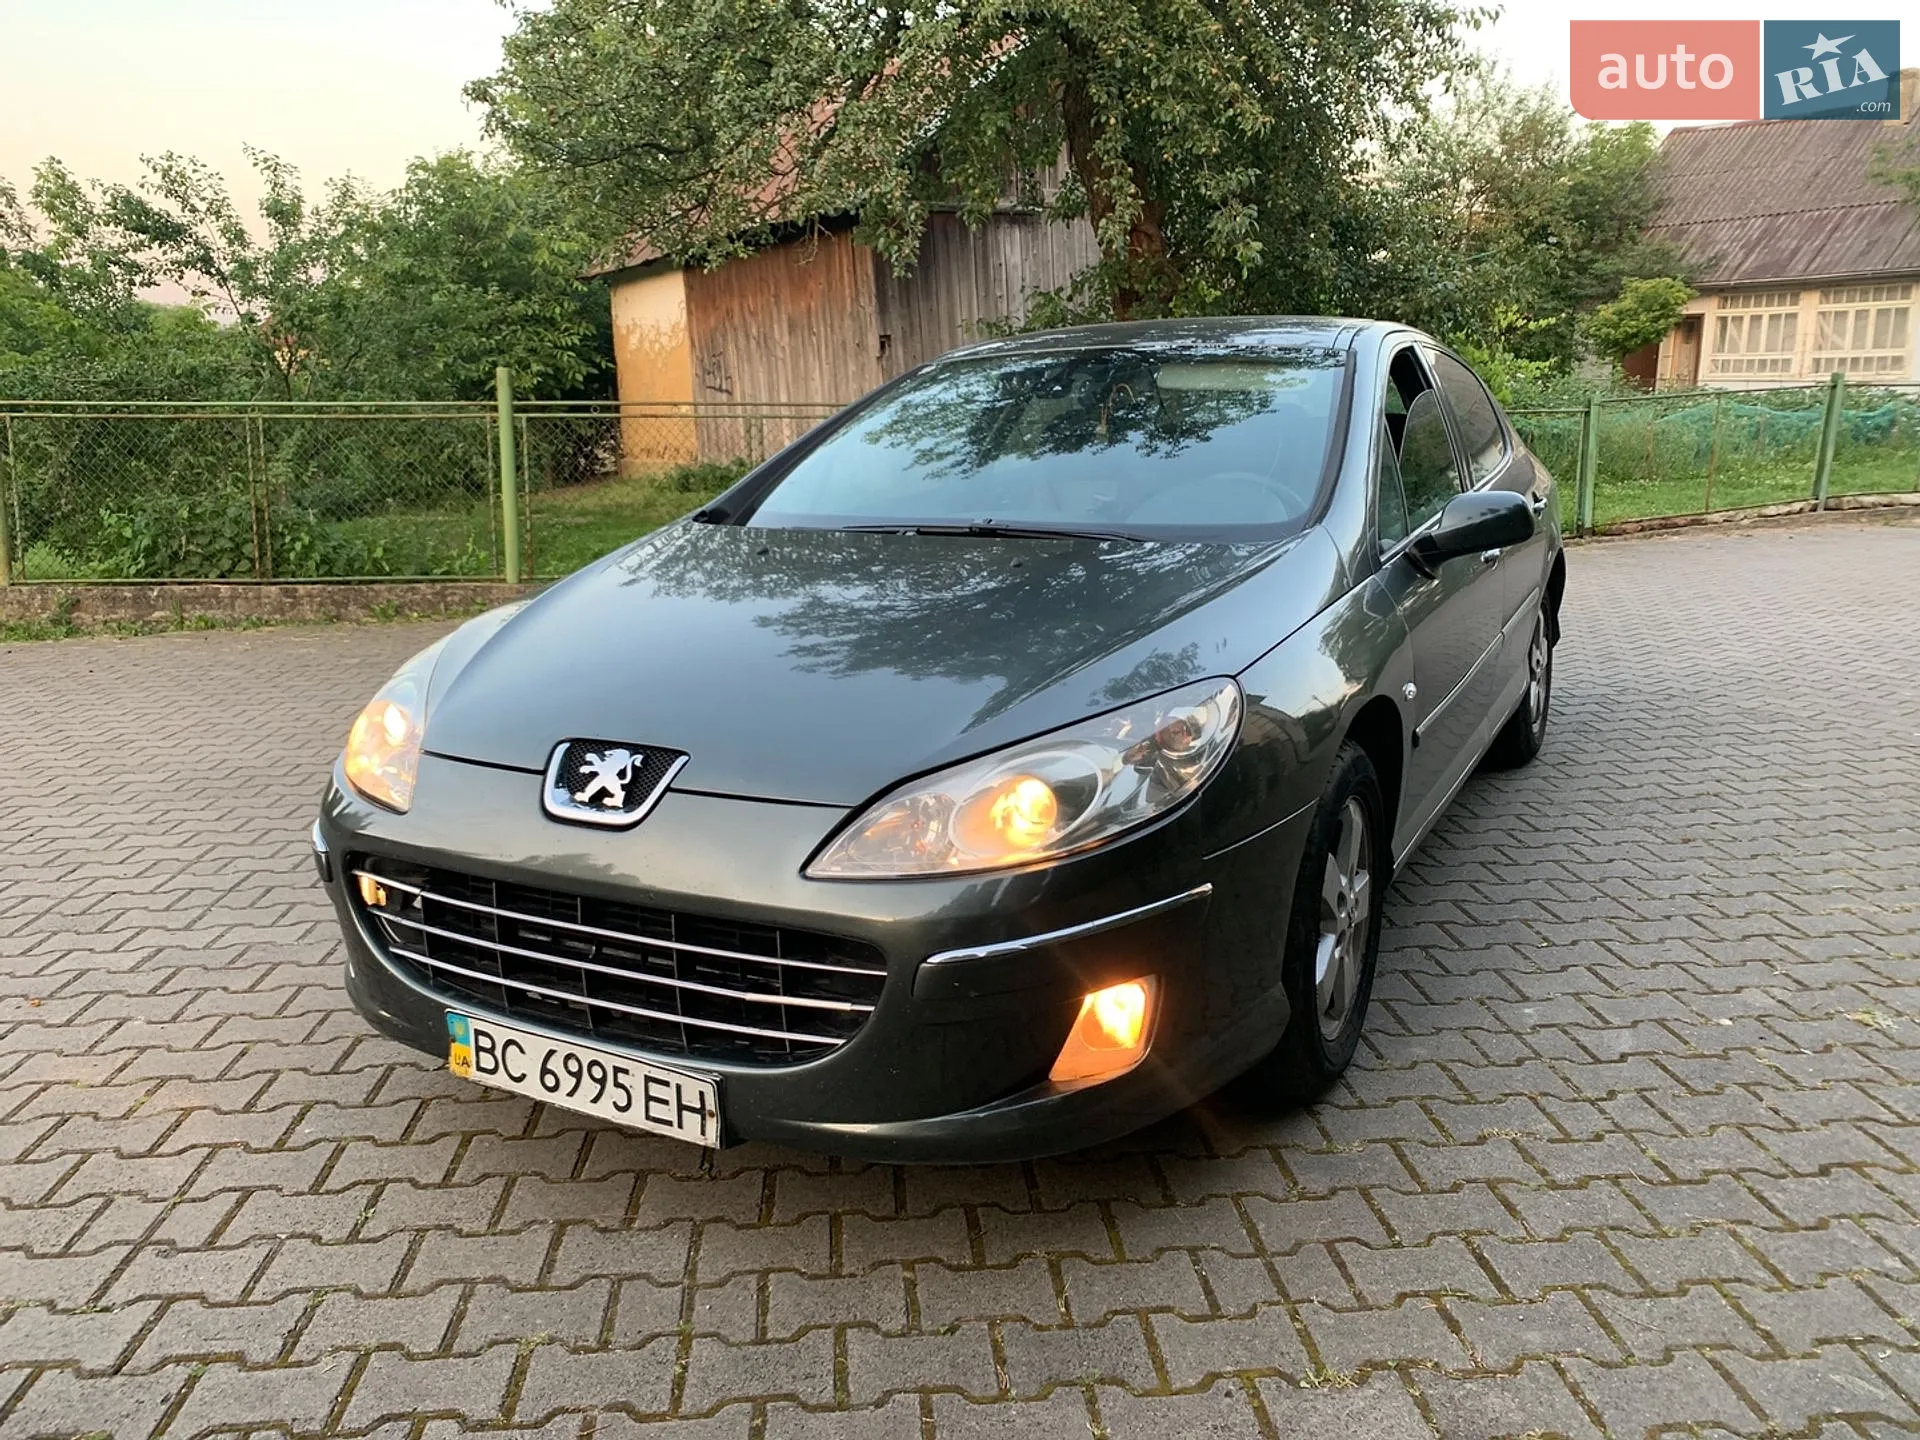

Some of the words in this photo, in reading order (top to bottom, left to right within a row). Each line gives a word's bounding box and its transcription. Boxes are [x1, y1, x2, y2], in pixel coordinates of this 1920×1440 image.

[454, 1053, 470, 1068] UA
[473, 1027, 528, 1084] BC
[539, 1048, 632, 1113] 6995
[643, 1073, 707, 1137] EH
